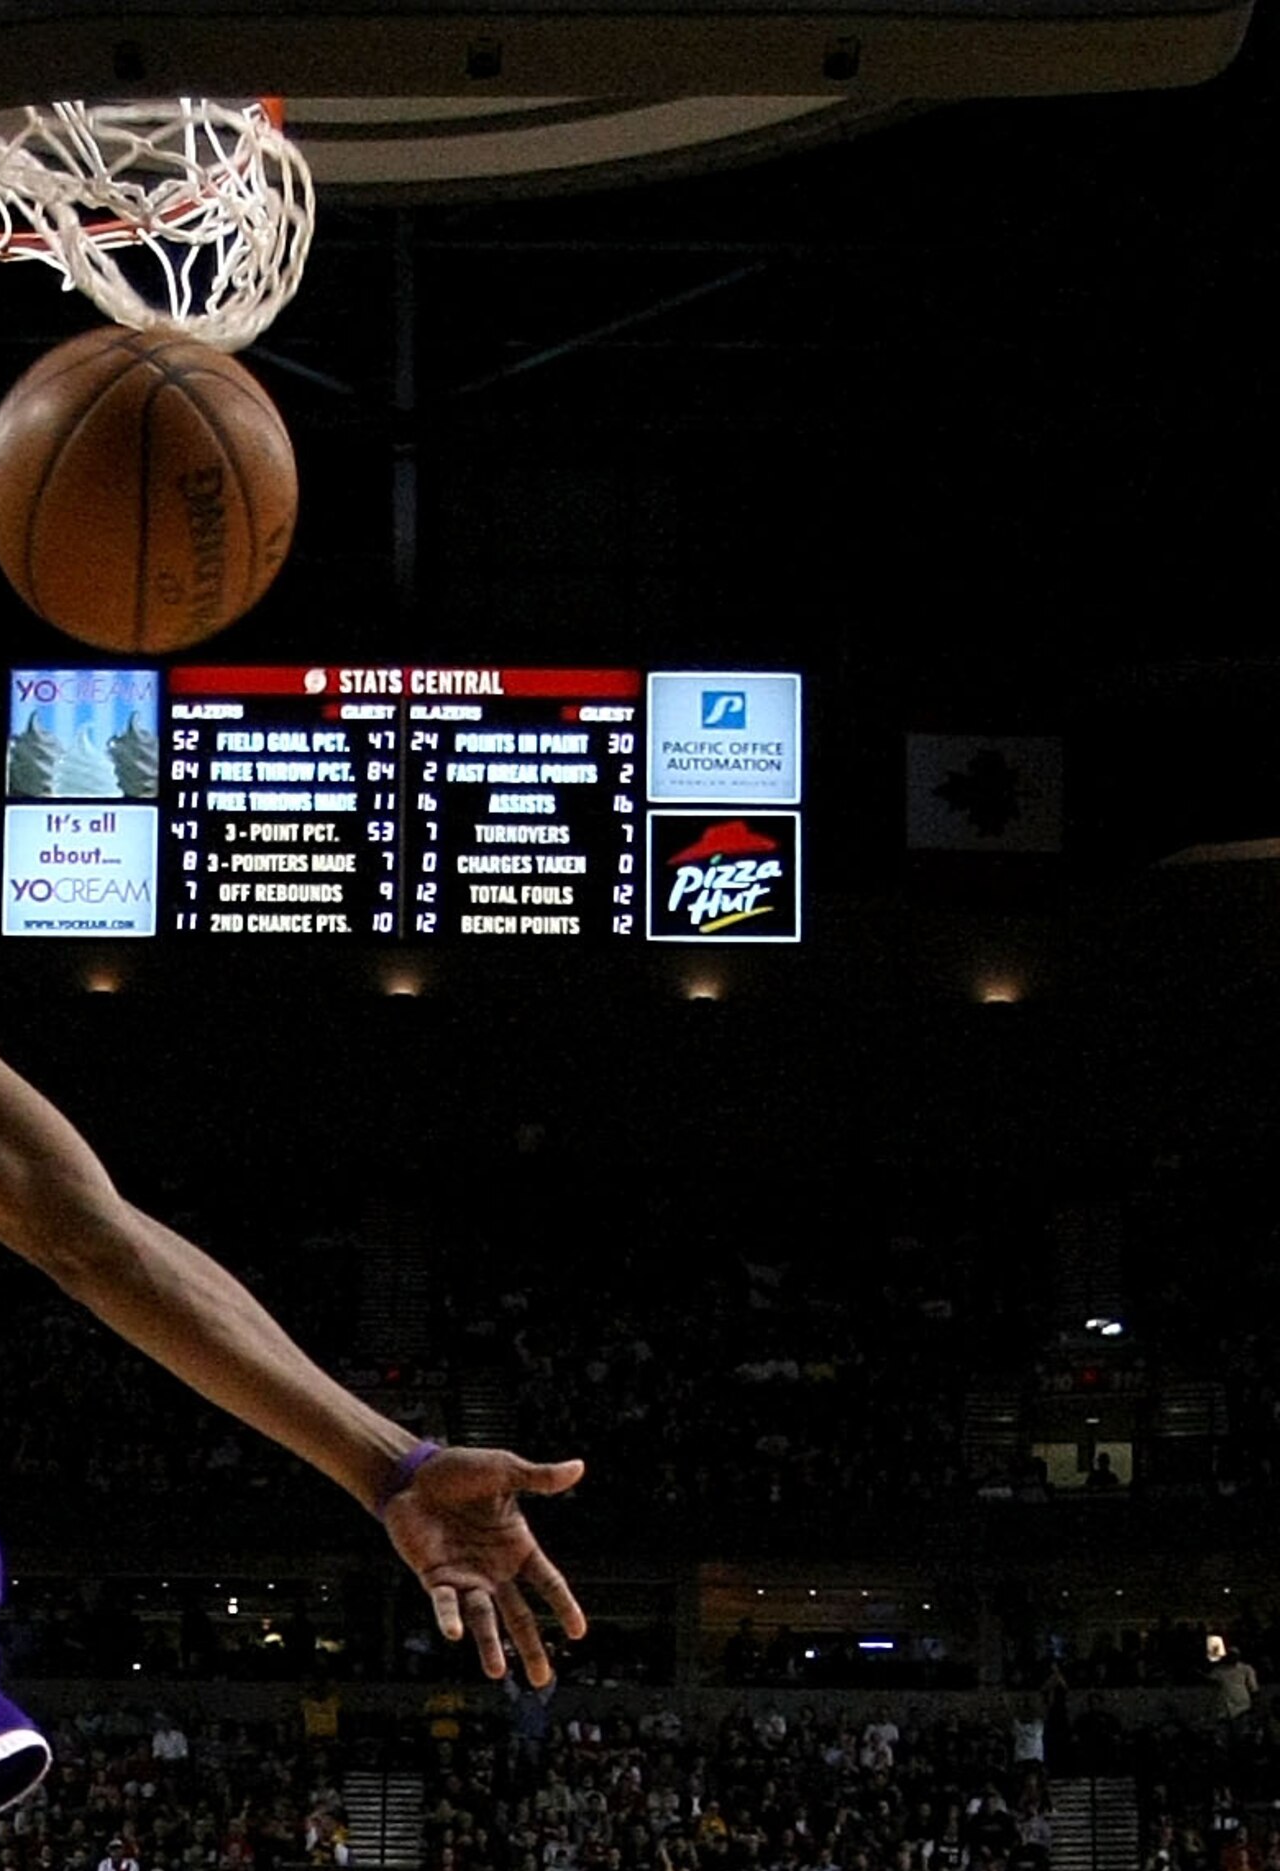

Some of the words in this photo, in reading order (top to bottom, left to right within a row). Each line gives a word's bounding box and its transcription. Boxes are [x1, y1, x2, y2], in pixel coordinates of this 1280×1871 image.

[16, 678, 153, 703] YOCREAM
[339, 669, 403, 694] STATS
[410, 670, 504, 695] CENTRAL
[172, 730, 200, 751] 52
[216, 732, 265, 752] FIELD
[266, 732, 311, 752] GOAL
[312, 732, 351, 752] PCT.
[368, 731, 395, 749] 47
[410, 731, 439, 751] 24
[454, 733, 515, 753] POINTS
[539, 734, 589, 754] PAINT
[608, 733, 634, 754] 30
[663, 741, 724, 755] PACIFIC
[729, 742, 783, 756] OFFICE
[171, 760, 199, 781] 84
[210, 761, 253, 782] FREE
[255, 761, 315, 782] THROW
[317, 761, 356, 782] PCT.
[367, 761, 395, 781] 84
[423, 761, 438, 782] 2
[446, 763, 485, 783] FAST
[487, 763, 538, 783] BREAK
[540, 763, 598, 784] POINTS
[619, 763, 634, 783] 2
[667, 757, 781, 771] AUTOMATION
[418, 793, 437, 811] 16
[488, 793, 556, 814] ASSISTS
[613, 795, 633, 813] 16
[47, 813, 81, 833] It's
[89, 812, 116, 832] all
[171, 821, 198, 839] 47
[303, 823, 340, 842] PCT.
[367, 821, 395, 842] 53
[426, 821, 437, 841] 7
[474, 824, 570, 844] TURNOVERS
[621, 824, 634, 843] 7
[183, 851, 198, 870] 8
[312, 854, 356, 872] MADE
[382, 852, 394, 870] 7
[422, 852, 437, 872] 0
[457, 855, 532, 874] CHARGES
[535, 856, 587, 874] TAKEN
[618, 854, 633, 874] 0
[10, 877, 151, 903] YOCREAM
[185, 880, 198, 900] 7
[219, 884, 252, 902] OFF
[254, 884, 343, 903] REBOUNDS
[379, 882, 394, 901] 9
[416, 882, 437, 902] 12
[469, 885, 518, 904] TOTAL
[521, 886, 574, 905] FOULS
[613, 884, 634, 905] 12
[690, 886, 770, 924] Hut
[176, 913, 198, 930] 11
[210, 914, 243, 932] 2ND
[247, 914, 313, 932] CHANCE
[316, 914, 352, 932] PTS.
[372, 912, 393, 932] 10
[416, 912, 437, 933] 12
[461, 915, 517, 934] BENCH
[520, 916, 580, 935] POINTS
[613, 914, 633, 935] 12
